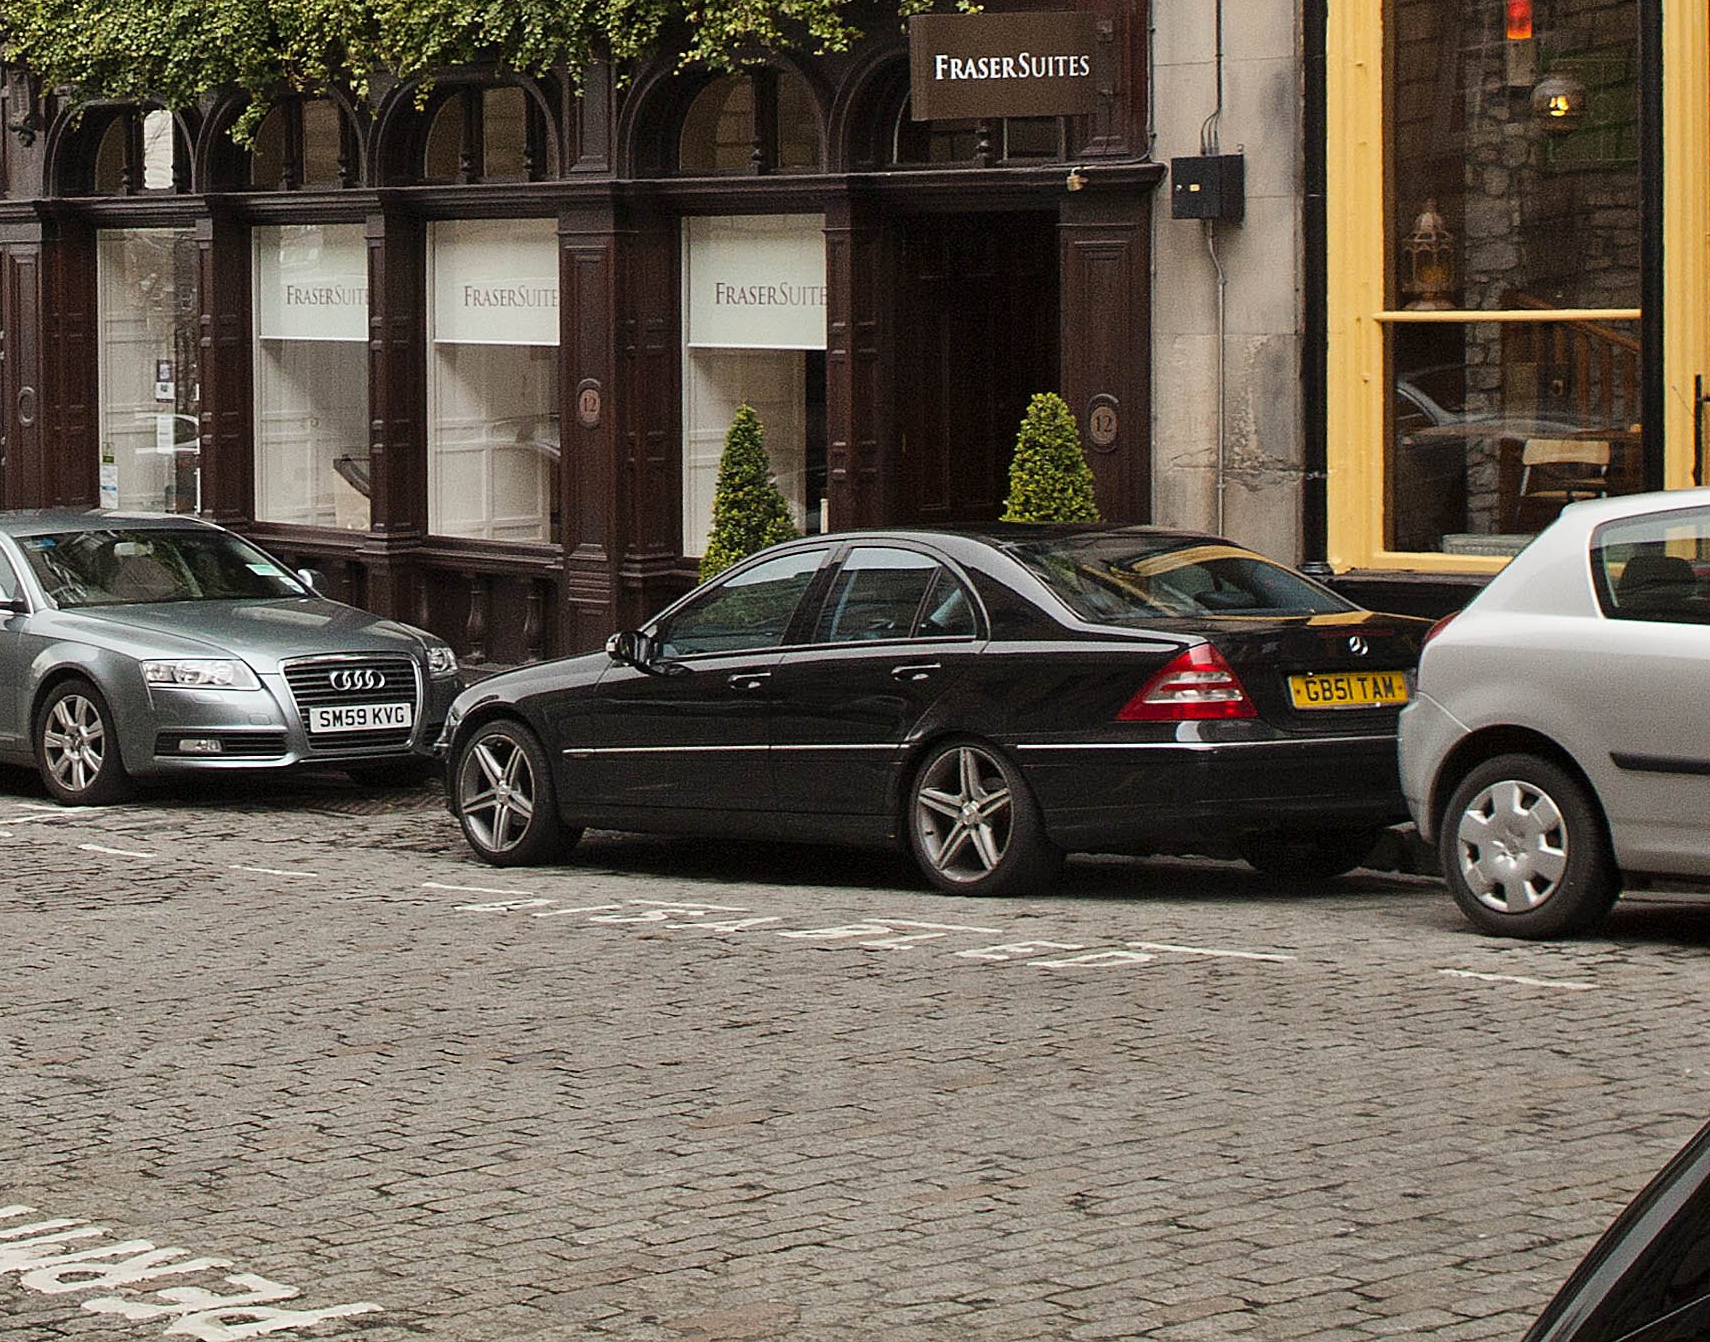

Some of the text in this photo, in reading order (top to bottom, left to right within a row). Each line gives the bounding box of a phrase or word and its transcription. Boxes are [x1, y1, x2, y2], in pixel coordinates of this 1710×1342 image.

[1305, 677, 1354, 702] GB51
[319, 706, 405, 728] SM59 KVG
[454, 897, 1157, 969] DISABLED
